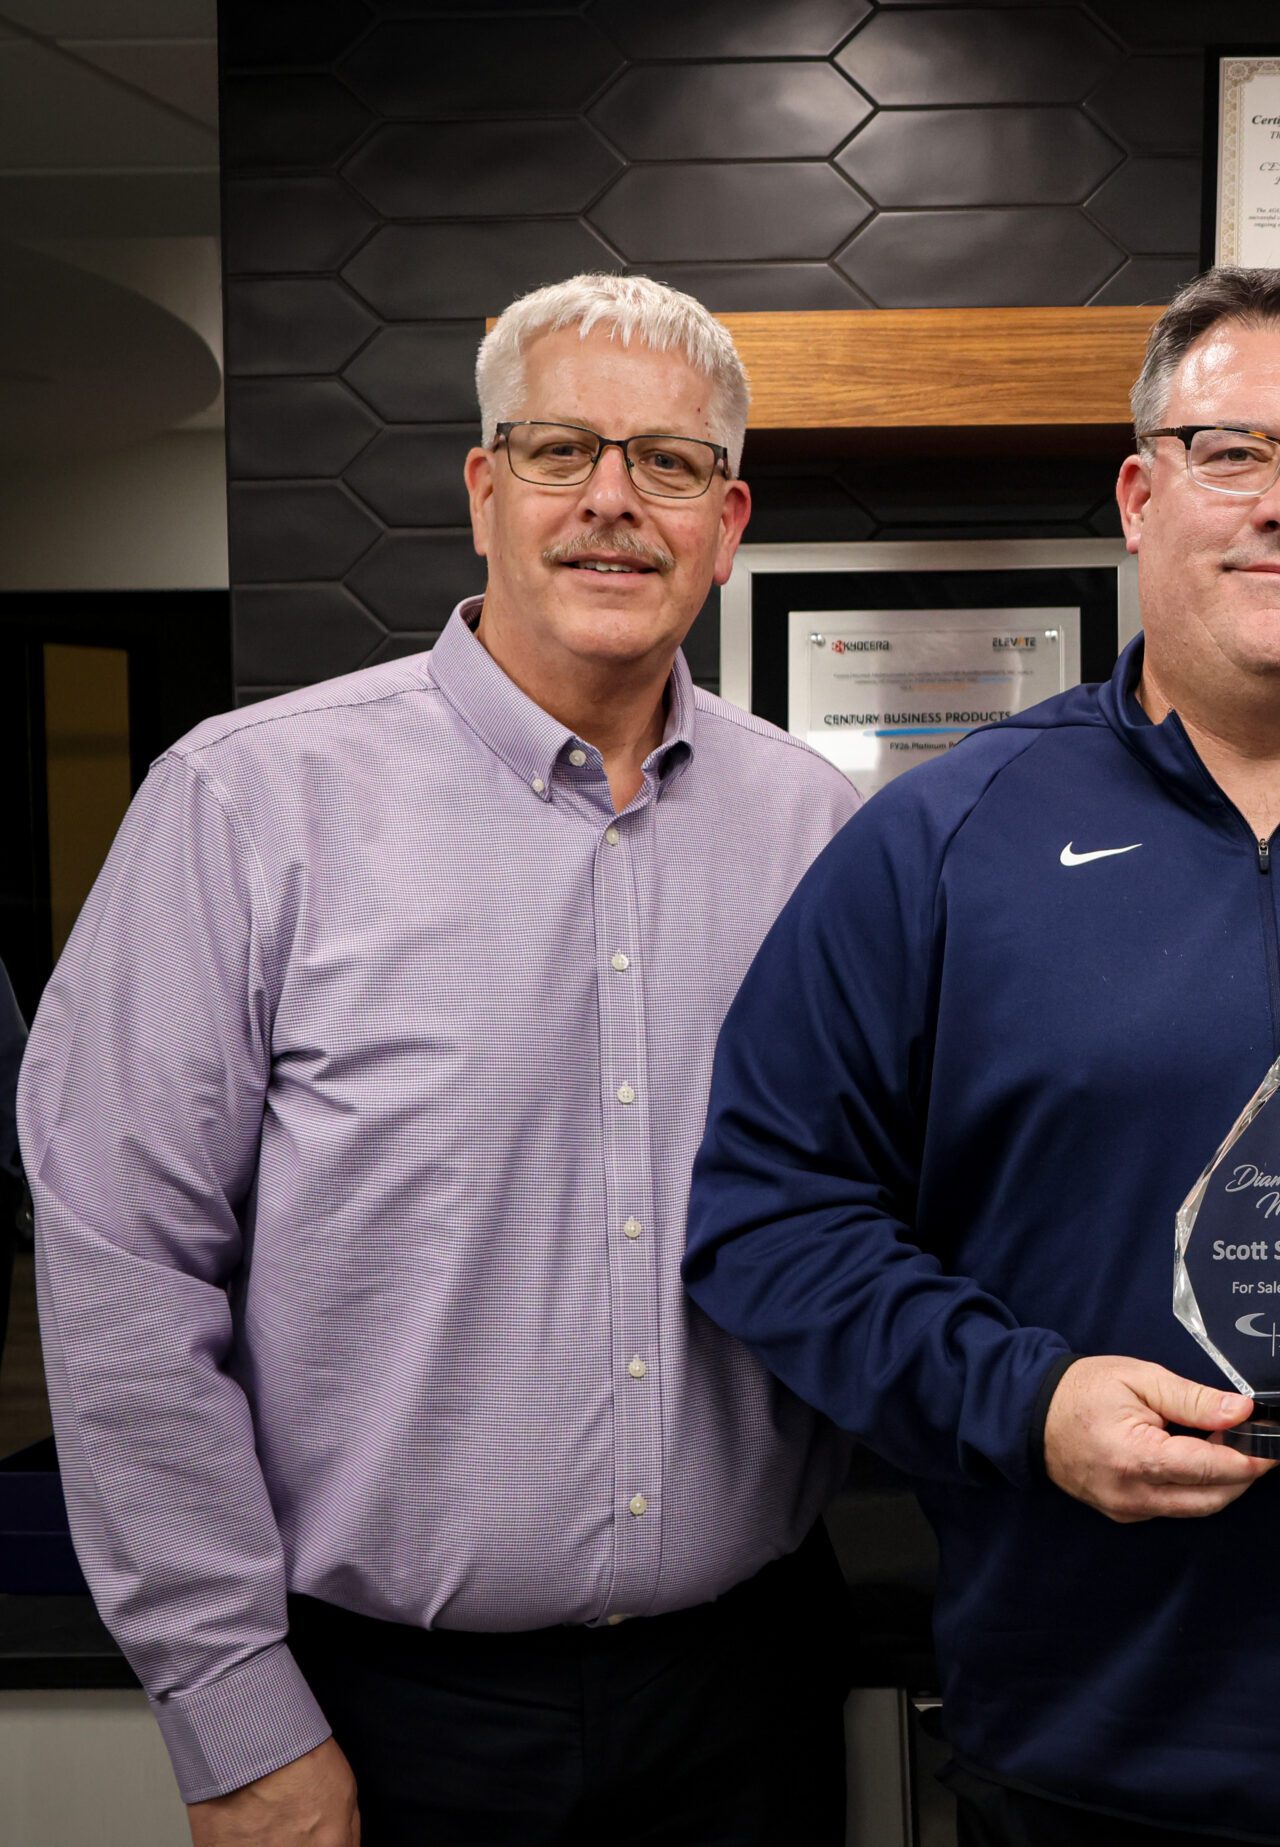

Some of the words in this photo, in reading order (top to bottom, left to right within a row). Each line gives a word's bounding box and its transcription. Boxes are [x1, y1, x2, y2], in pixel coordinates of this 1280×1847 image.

[844, 640, 889, 650] KYOCERA
[824, 714, 880, 725] CENTURY
[884, 712, 942, 724] BUSINESS
[945, 711, 1011, 723] PRODUCTS
[911, 742, 947, 750] Platinum
[1212, 1240, 1268, 1260] Scott
[1232, 1281, 1254, 1294] For
